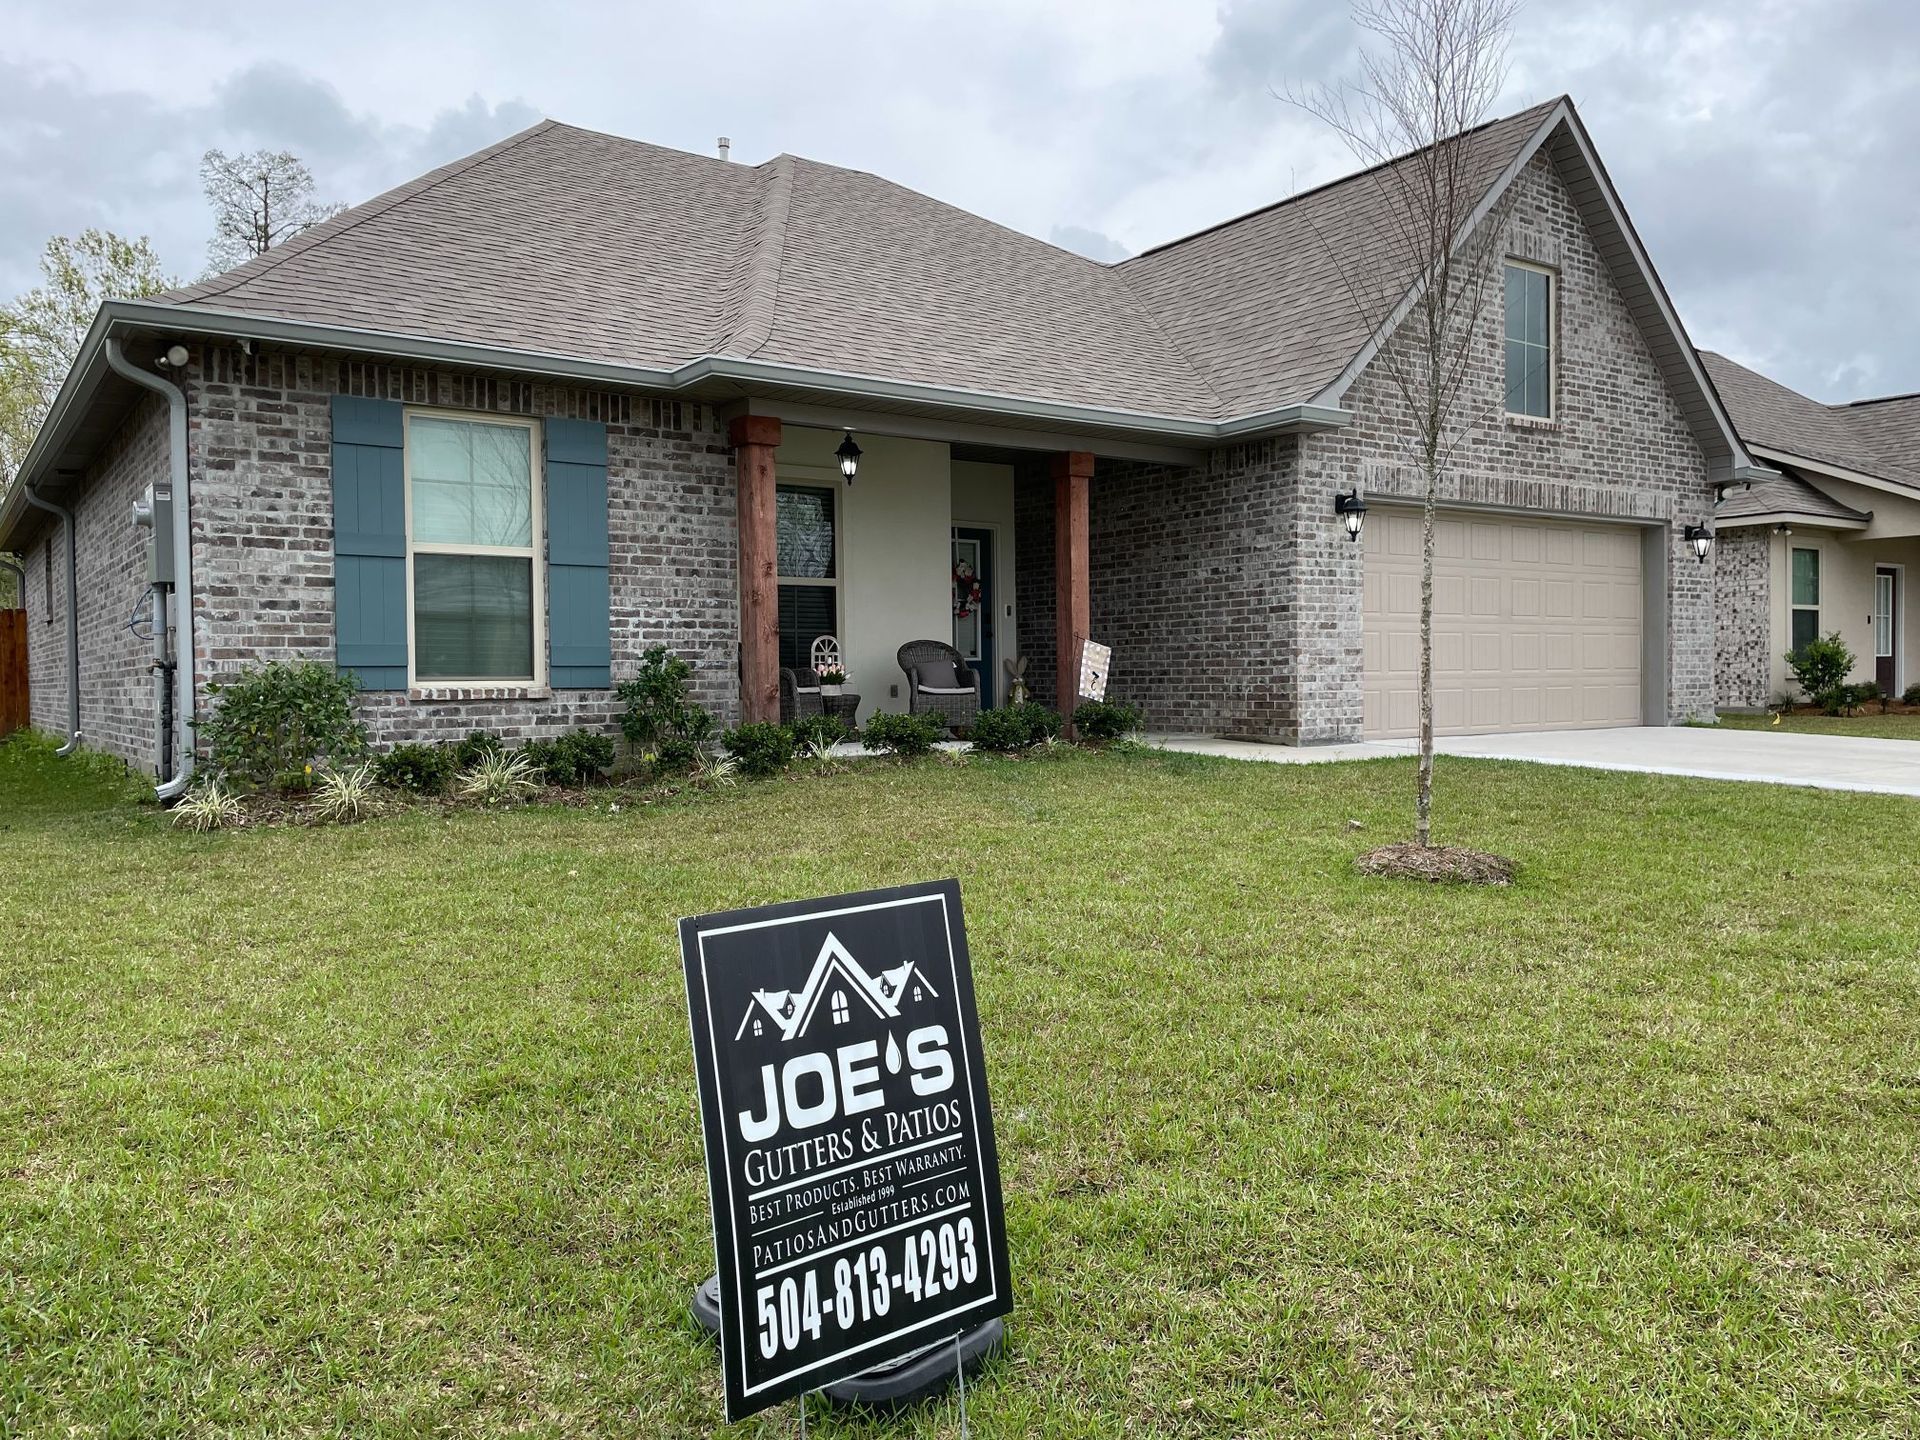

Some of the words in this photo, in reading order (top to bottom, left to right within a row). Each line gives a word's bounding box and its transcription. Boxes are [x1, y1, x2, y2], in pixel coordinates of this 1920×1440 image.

[744, 1128, 853, 1187] GUTTERS
[861, 1118, 882, 1152] &
[884, 1099, 962, 1147] PATIOS
[749, 1199, 782, 1225] BEST
[786, 1178, 859, 1215] PRODUCTS.
[863, 1166, 893, 1188] BEST
[895, 1144, 967, 1178] WARRANTY.
[831, 1191, 876, 1215] Established
[877, 1184, 895, 1202] 1999
[757, 1216, 978, 1360] 504-813-4293
